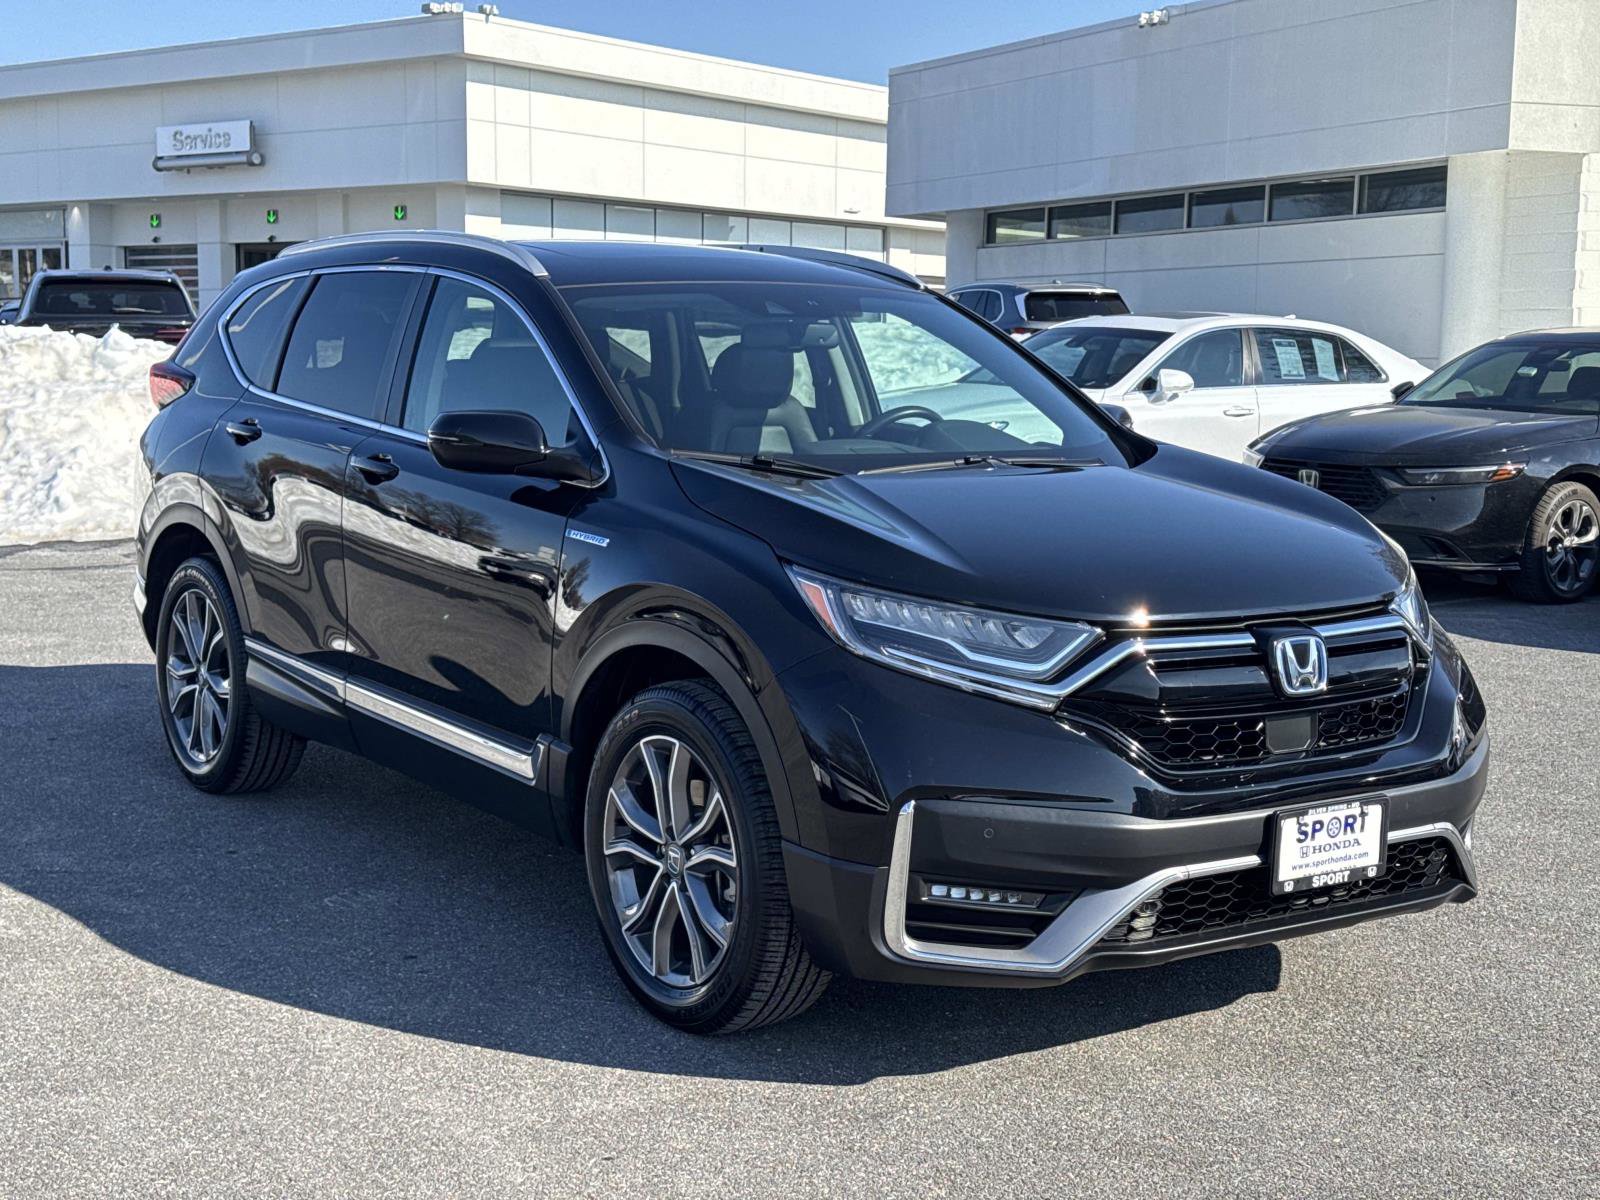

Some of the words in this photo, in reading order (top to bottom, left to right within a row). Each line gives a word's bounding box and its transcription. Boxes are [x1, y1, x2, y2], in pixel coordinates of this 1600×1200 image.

[172, 127, 231, 151] Service
[571, 531, 605, 545] HYBRID
[1296, 812, 1369, 843] SPORT
[1312, 838, 1361, 854] HONDA
[1291, 851, 1369, 872] www.sporthonda.com
[1312, 871, 1350, 888] SPORT
